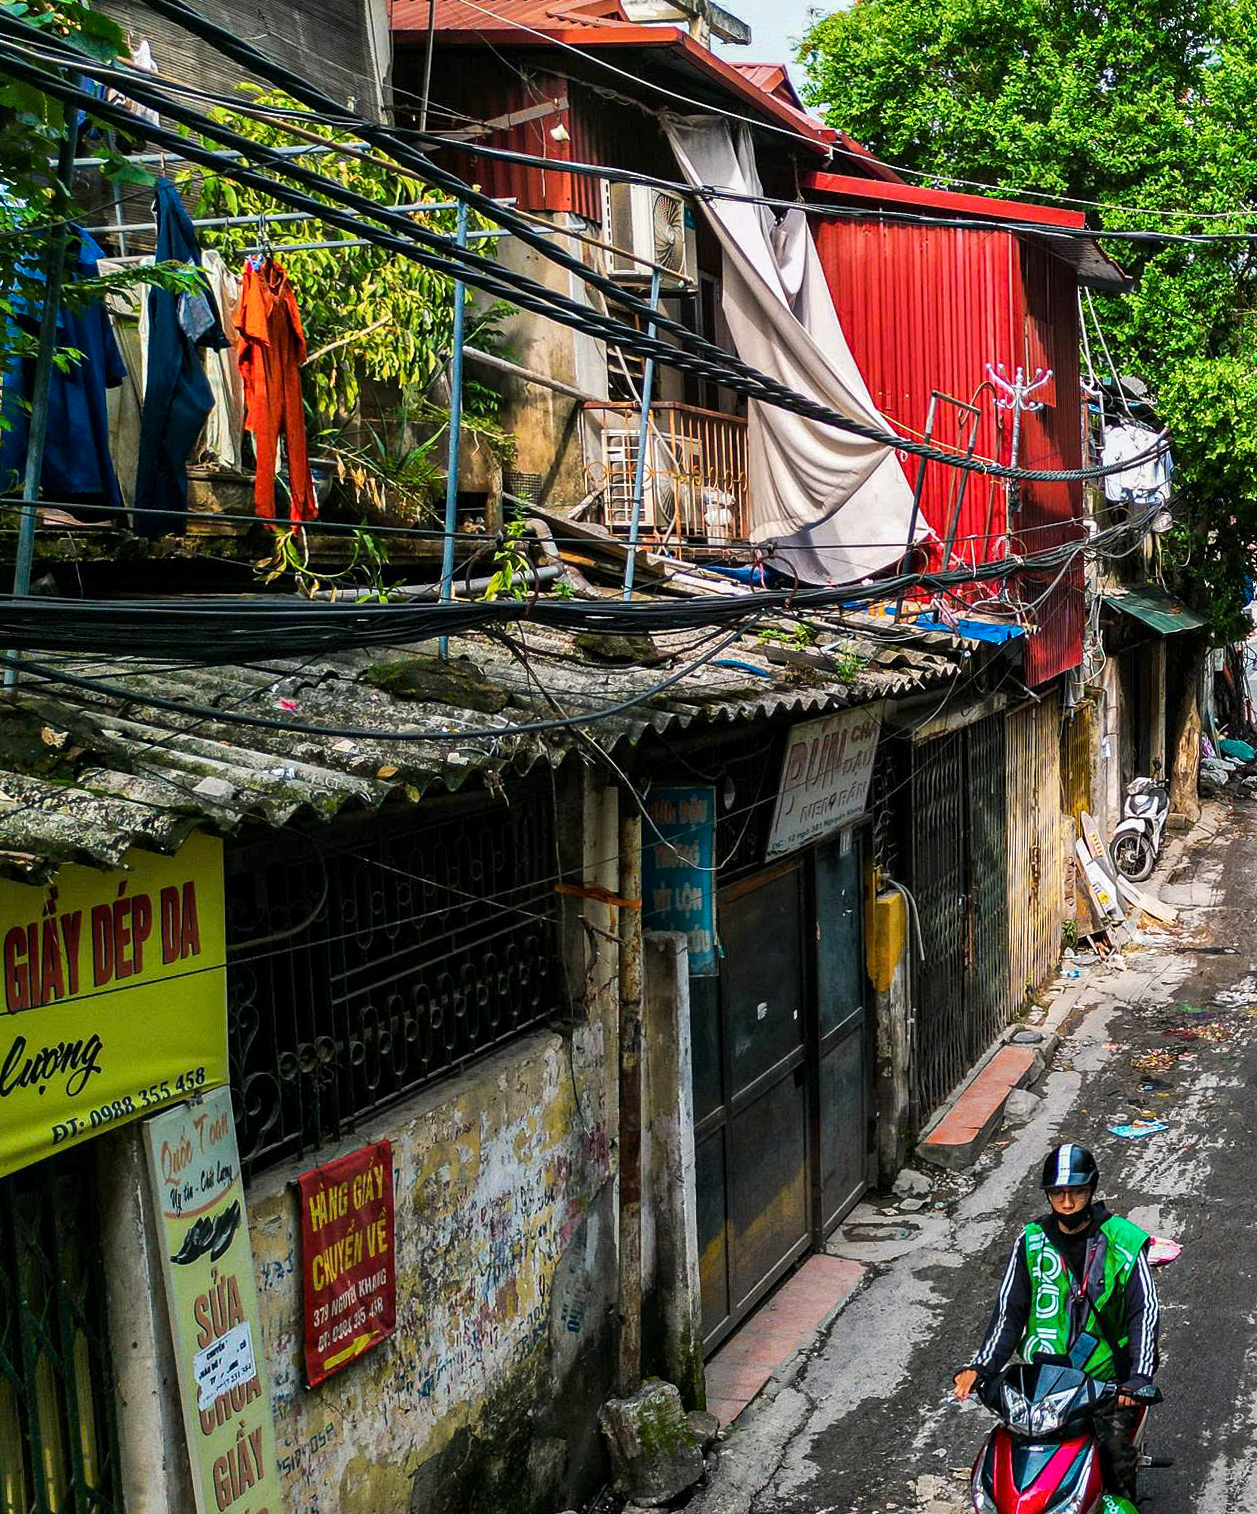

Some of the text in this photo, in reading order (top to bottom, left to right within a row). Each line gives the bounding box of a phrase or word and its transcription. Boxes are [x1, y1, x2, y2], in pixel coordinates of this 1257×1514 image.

[91, 879, 153, 988] DÉP
[160, 881, 201, 965] DA
[52, 1066, 205, 1146] ĐT: 0988 355 458
[309, 1182, 348, 1232] HÀNG
[366, 1206, 388, 1258] VỀ
[194, 1266, 245, 1350] SỬA
[213, 1420, 264, 1512] GIẦY
